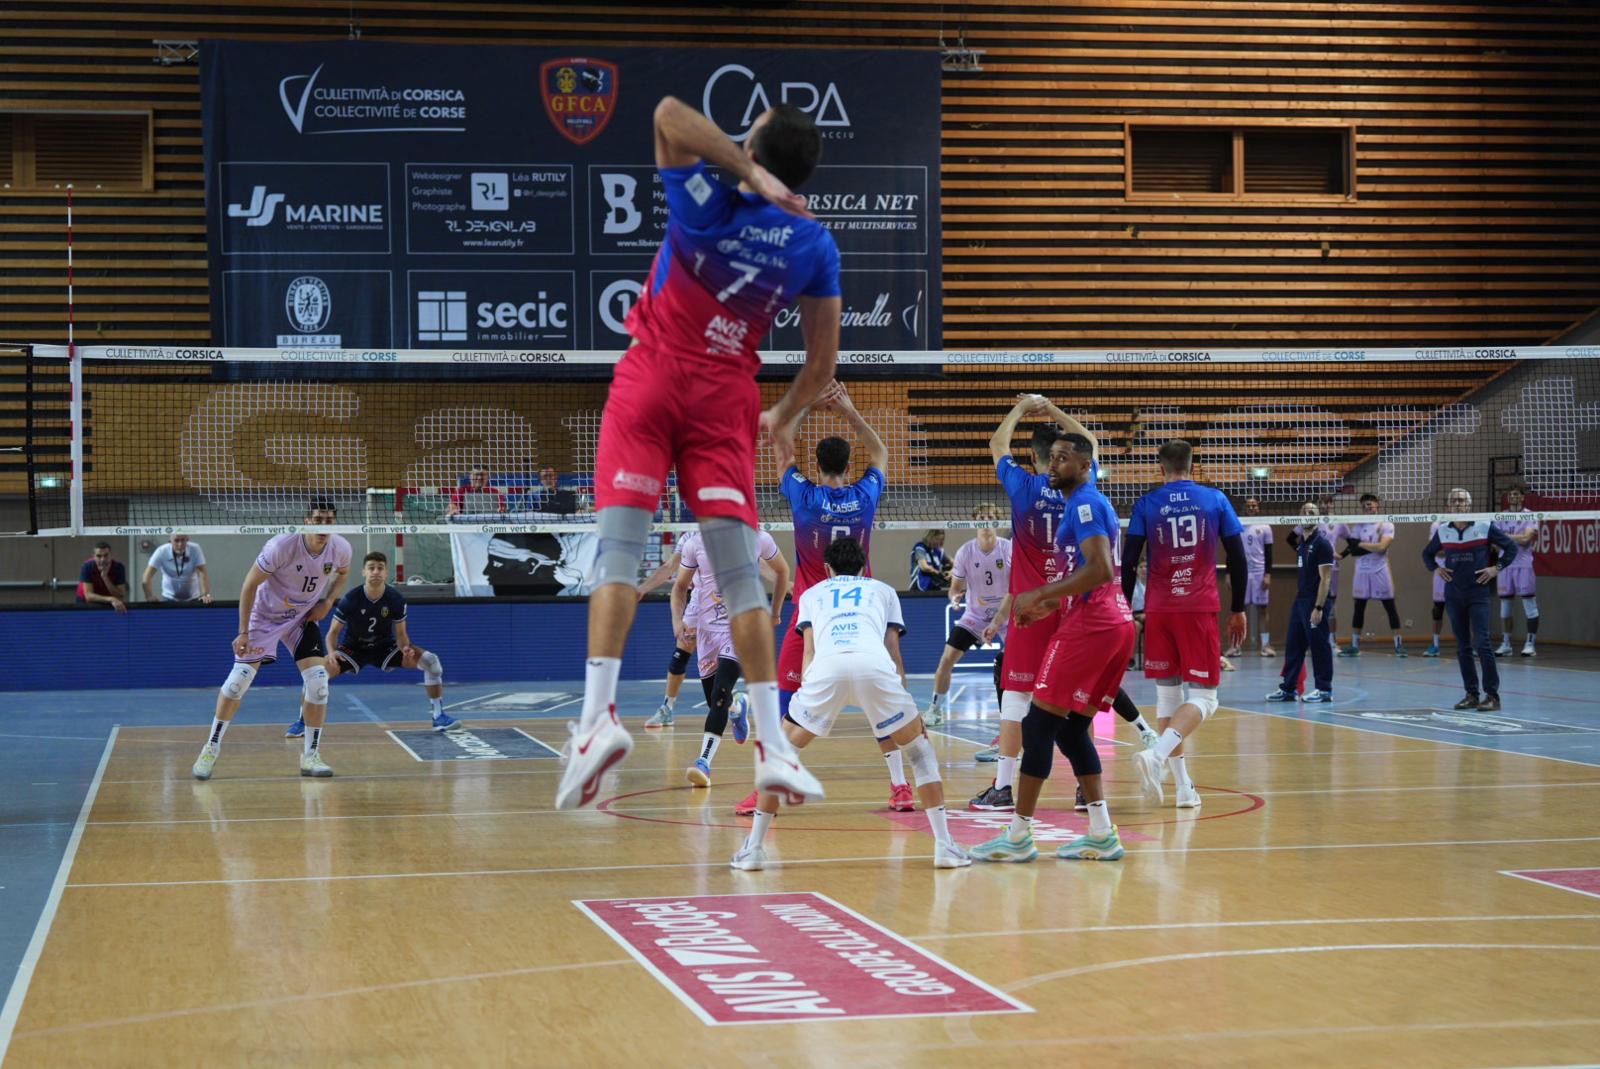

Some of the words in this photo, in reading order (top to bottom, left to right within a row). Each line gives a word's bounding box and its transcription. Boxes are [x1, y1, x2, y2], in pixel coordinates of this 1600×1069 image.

[314, 86, 390, 101] CULLETTIVITÀ
[403, 88, 465, 101] CORSICA
[551, 96, 608, 112] GFCA
[314, 104, 400, 118] COLLECTIVITÉ
[419, 106, 466, 118] CORSE
[412, 172, 463, 181] Webdesigner
[532, 173, 567, 182] RUTILY
[412, 186, 453, 196] Graphiste
[412, 202, 466, 212] Photographe
[807, 194, 867, 210] RSICA
[874, 194, 918, 210] NET
[285, 204, 383, 222] MARINE
[847, 221, 918, 230] MULTISERVICES
[716, 261, 762, 303] 7
[476, 291, 568, 328] secic
[281, 336, 336, 344] BUREAU
[477, 331, 540, 341] immobilier
[105, 348, 165, 359] CULLETTIVITÀ
[175, 350, 224, 359] CORSICA
[281, 350, 348, 361] COLLECTIVITÉ
[361, 352, 397, 361] CORSE
[452, 351, 510, 362] CULLETTIVITÀ
[519, 353, 566, 362] CORSICA
[947, 352, 1008, 362] COLLECTIVITÉ
[1022, 353, 1055, 362] CORSE
[1106, 351, 1158, 361] CULLETTIVITÀ
[1168, 353, 1211, 361] CORSICA
[1261, 350, 1321, 360] COLLECTIVITÉ
[1334, 351, 1365, 360] CORSE
[1415, 349, 1466, 359] CULLETTIVITÀ
[1475, 350, 1516, 358] CORSICA
[1565, 348, 1600, 358] COLLEC
[850, 354, 895, 363] CORSICA
[1169, 492, 1190, 502] GILL
[822, 499, 861, 514] LACASSIE
[1387, 515, 1410, 523] Gamm
[1494, 513, 1517, 521] Gamm
[1519, 513, 1536, 521] vert
[239, 525, 265, 534] Gamm
[268, 525, 286, 534] vert
[361, 525, 387, 534] Gamm
[390, 525, 407, 534] vert
[481, 524, 507, 533] Gamm
[510, 524, 527, 533] vert
[947, 521, 970, 529] Gamm
[973, 521, 989, 529] vert
[115, 526, 142, 535] Gamm
[144, 526, 162, 535] vert
[1167, 514, 1198, 549] 13
[1553, 519, 1572, 553] du
[1172, 567, 1193, 578] AVIS
[985, 571, 993, 586] 3
[301, 575, 319, 593] 15
[830, 586, 862, 609] 14
[367, 617, 377, 633] 2
[831, 622, 859, 631] AVIS
[614, 901, 748, 947] Budget
[837, 951, 956, 995] GROUPE
[697, 971, 847, 1014] AVIS
